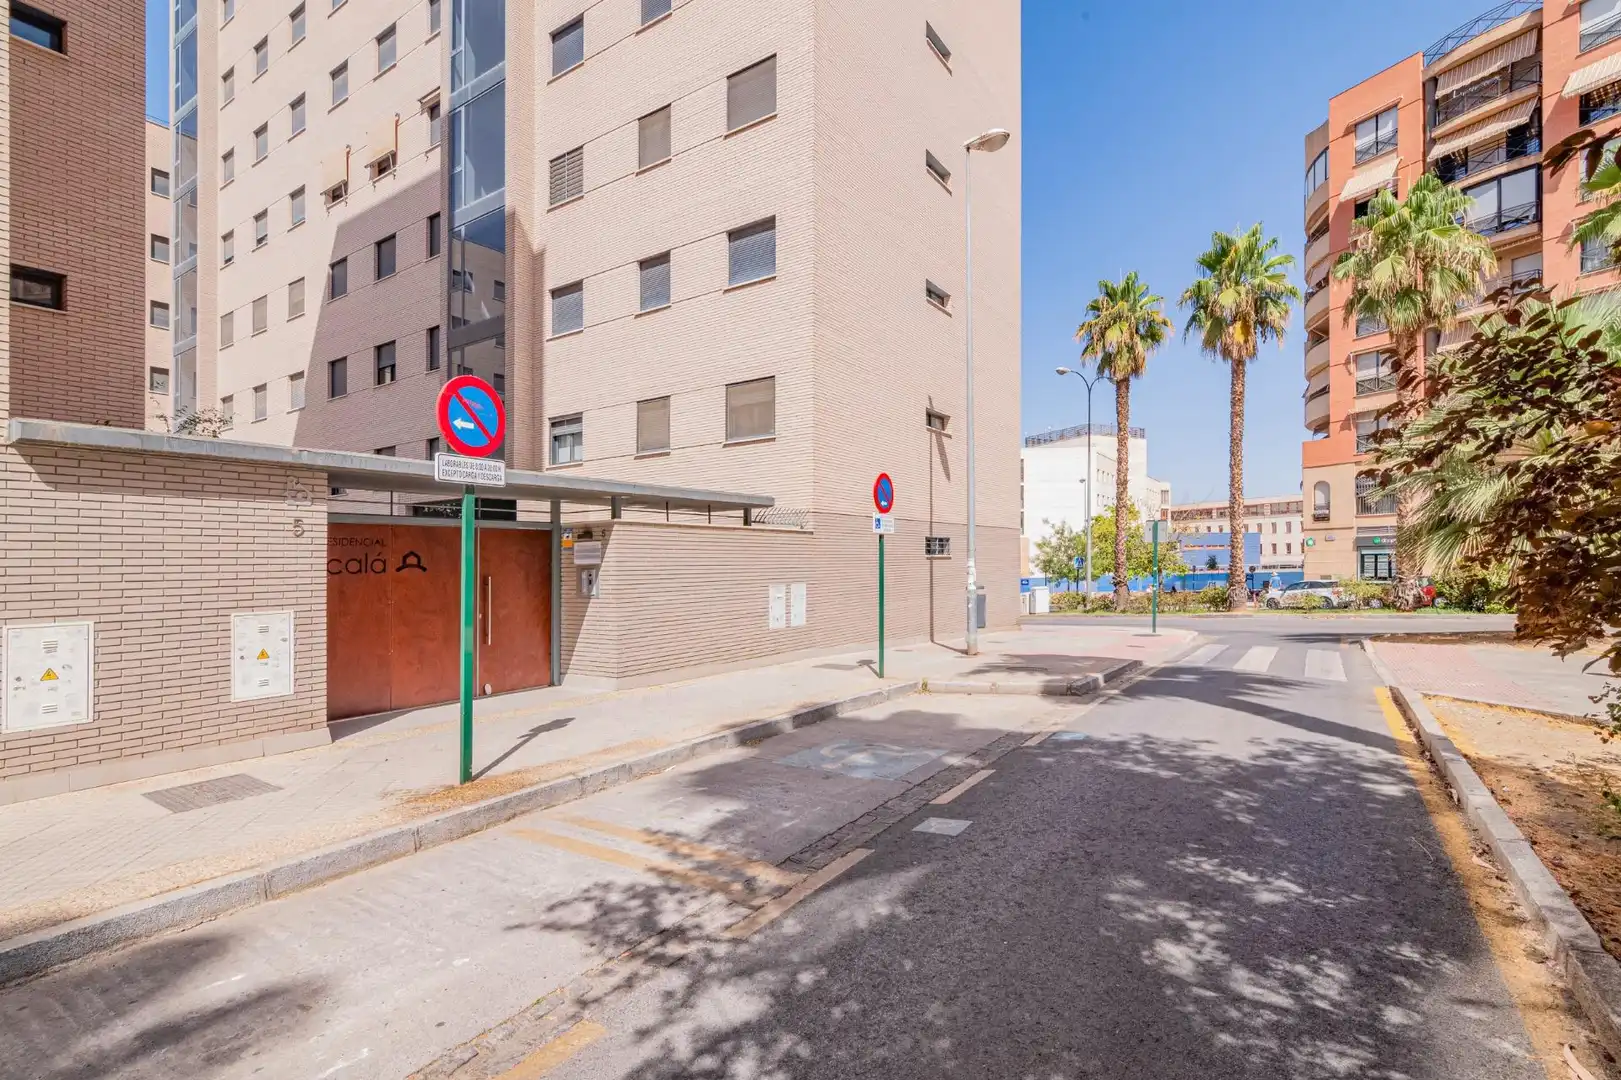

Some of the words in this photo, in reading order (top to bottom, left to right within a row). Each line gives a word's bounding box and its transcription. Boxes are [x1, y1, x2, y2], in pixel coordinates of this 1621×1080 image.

[442, 459, 469, 470] LABORABLES
[442, 469, 462, 478] EXCEPTO
[462, 471, 477, 479] CARGA
[480, 473, 502, 482] DESCARGA
[293, 519, 305, 537] 5
[328, 536, 387, 547] ESIDENCIAL
[327, 552, 387, 575] calá
